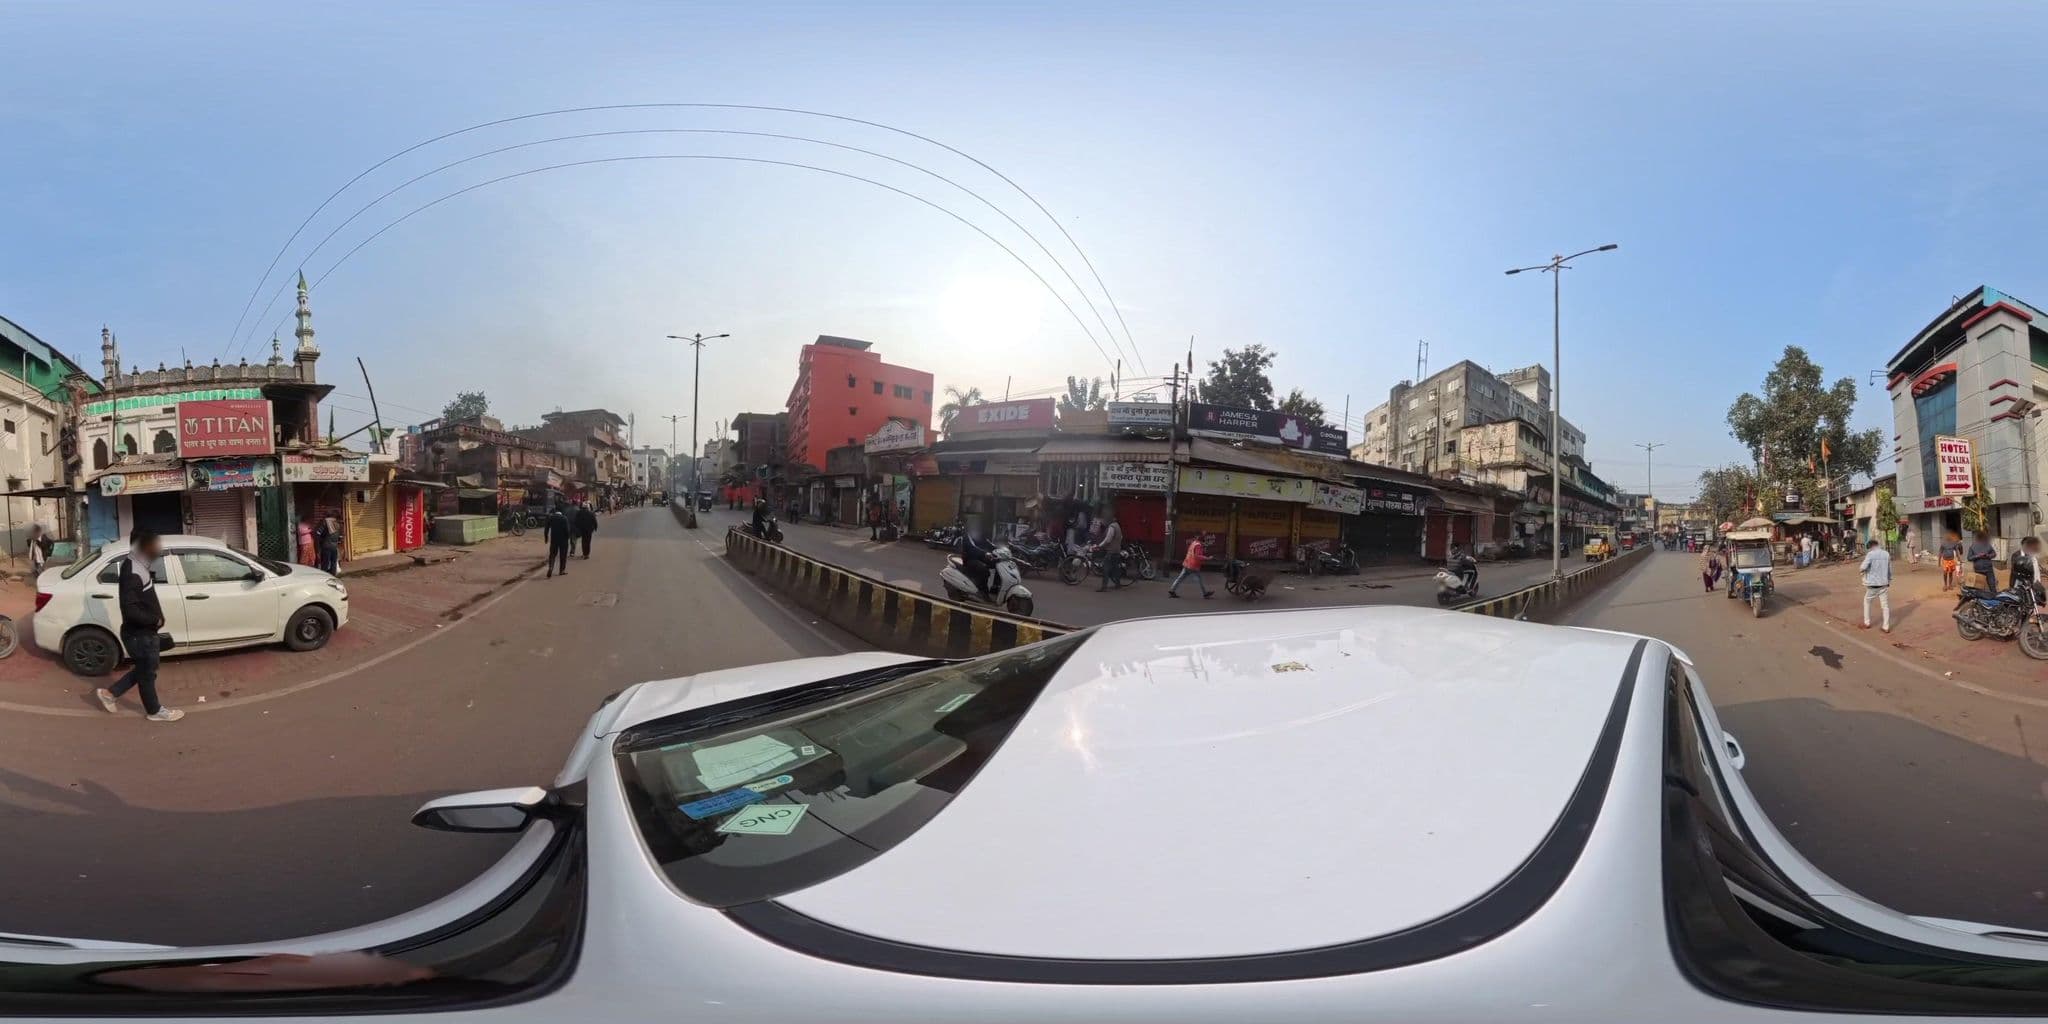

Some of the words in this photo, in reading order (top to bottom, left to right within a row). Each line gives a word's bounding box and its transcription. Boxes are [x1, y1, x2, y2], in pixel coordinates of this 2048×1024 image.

[978, 405, 1030, 423] EXIDE
[202, 416, 264, 434] TITAN
[1218, 417, 1258, 428] HARPER
[1941, 443, 1969, 454] HOTEL
[1941, 455, 1947, 464] K
[1947, 456, 1970, 464] KALIKA
[1135, 474, 1151, 482] पूजा
[1153, 475, 1166, 483] घर
[739, 809, 791, 828] CNG
